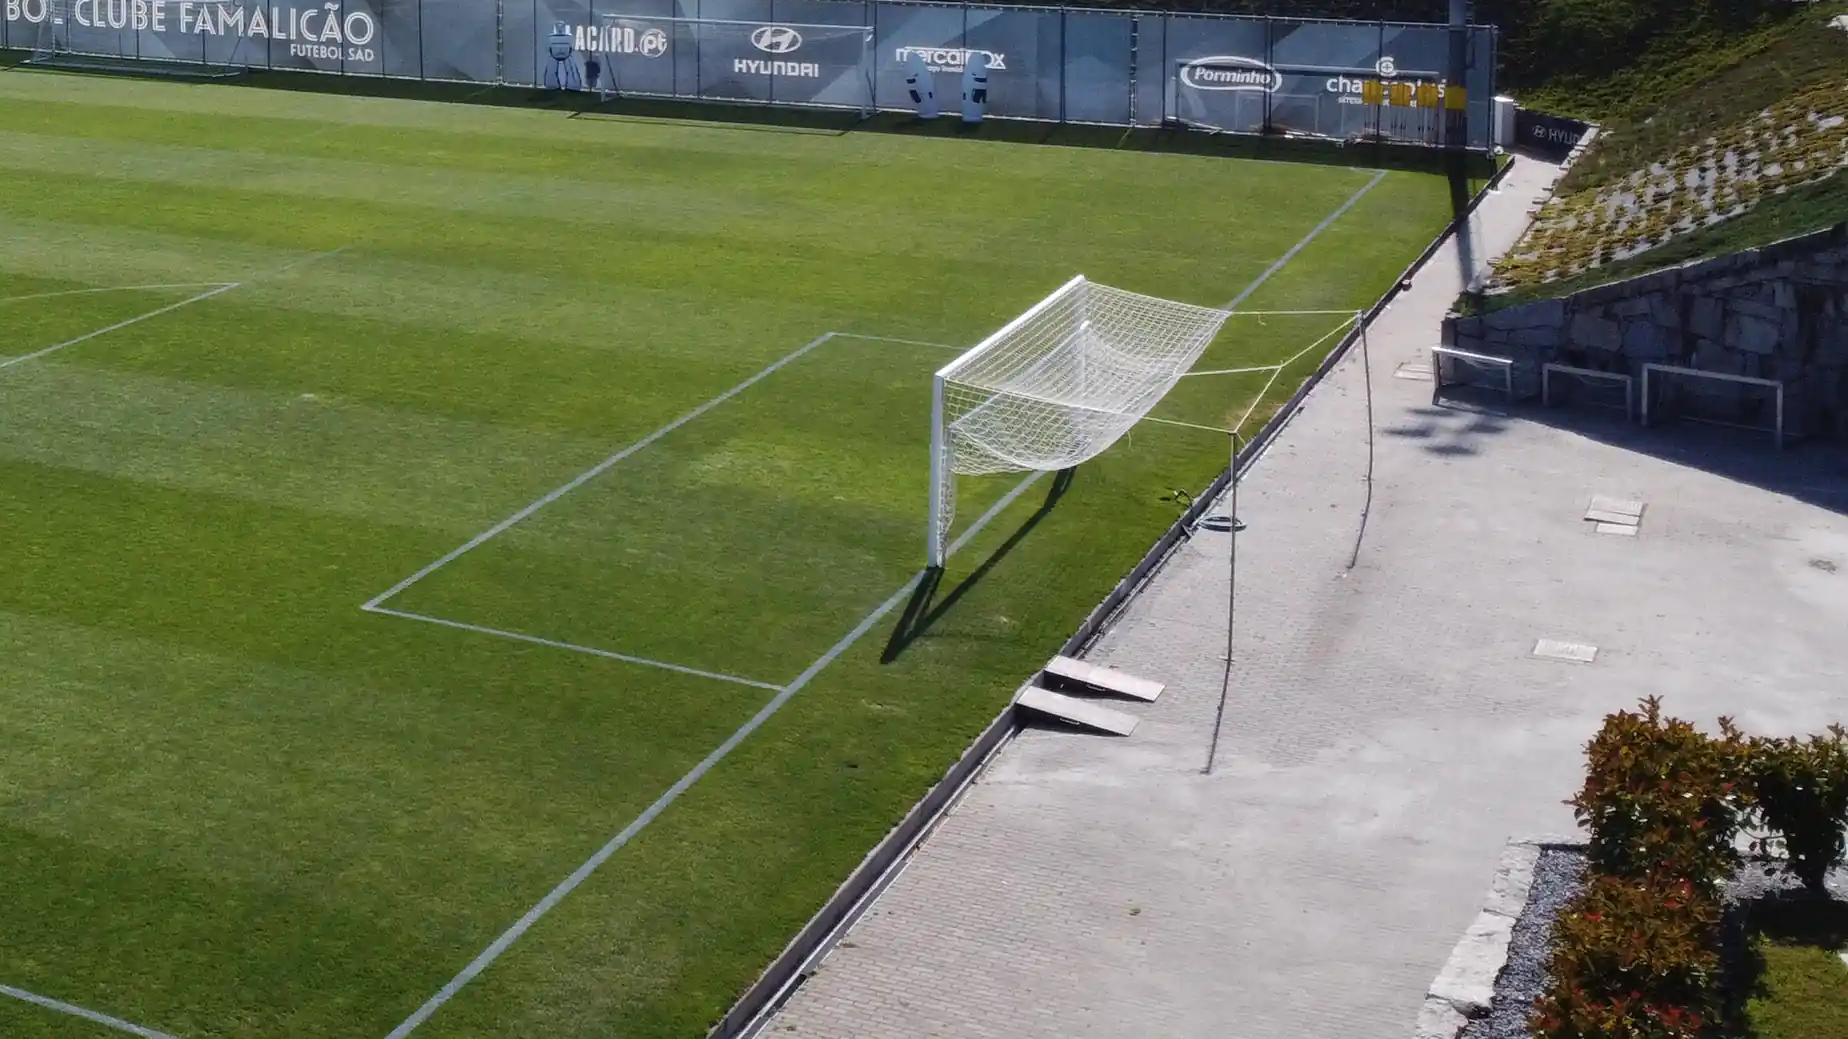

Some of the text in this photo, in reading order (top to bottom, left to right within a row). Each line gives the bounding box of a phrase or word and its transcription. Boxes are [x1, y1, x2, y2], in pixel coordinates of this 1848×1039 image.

[179, 1, 374, 45] FAMALICÃO
[290, 43, 375, 62] FUTEBOL SAD
[733, 58, 819, 78] HYUNDAI
[1194, 66, 1271, 84] Porminho
